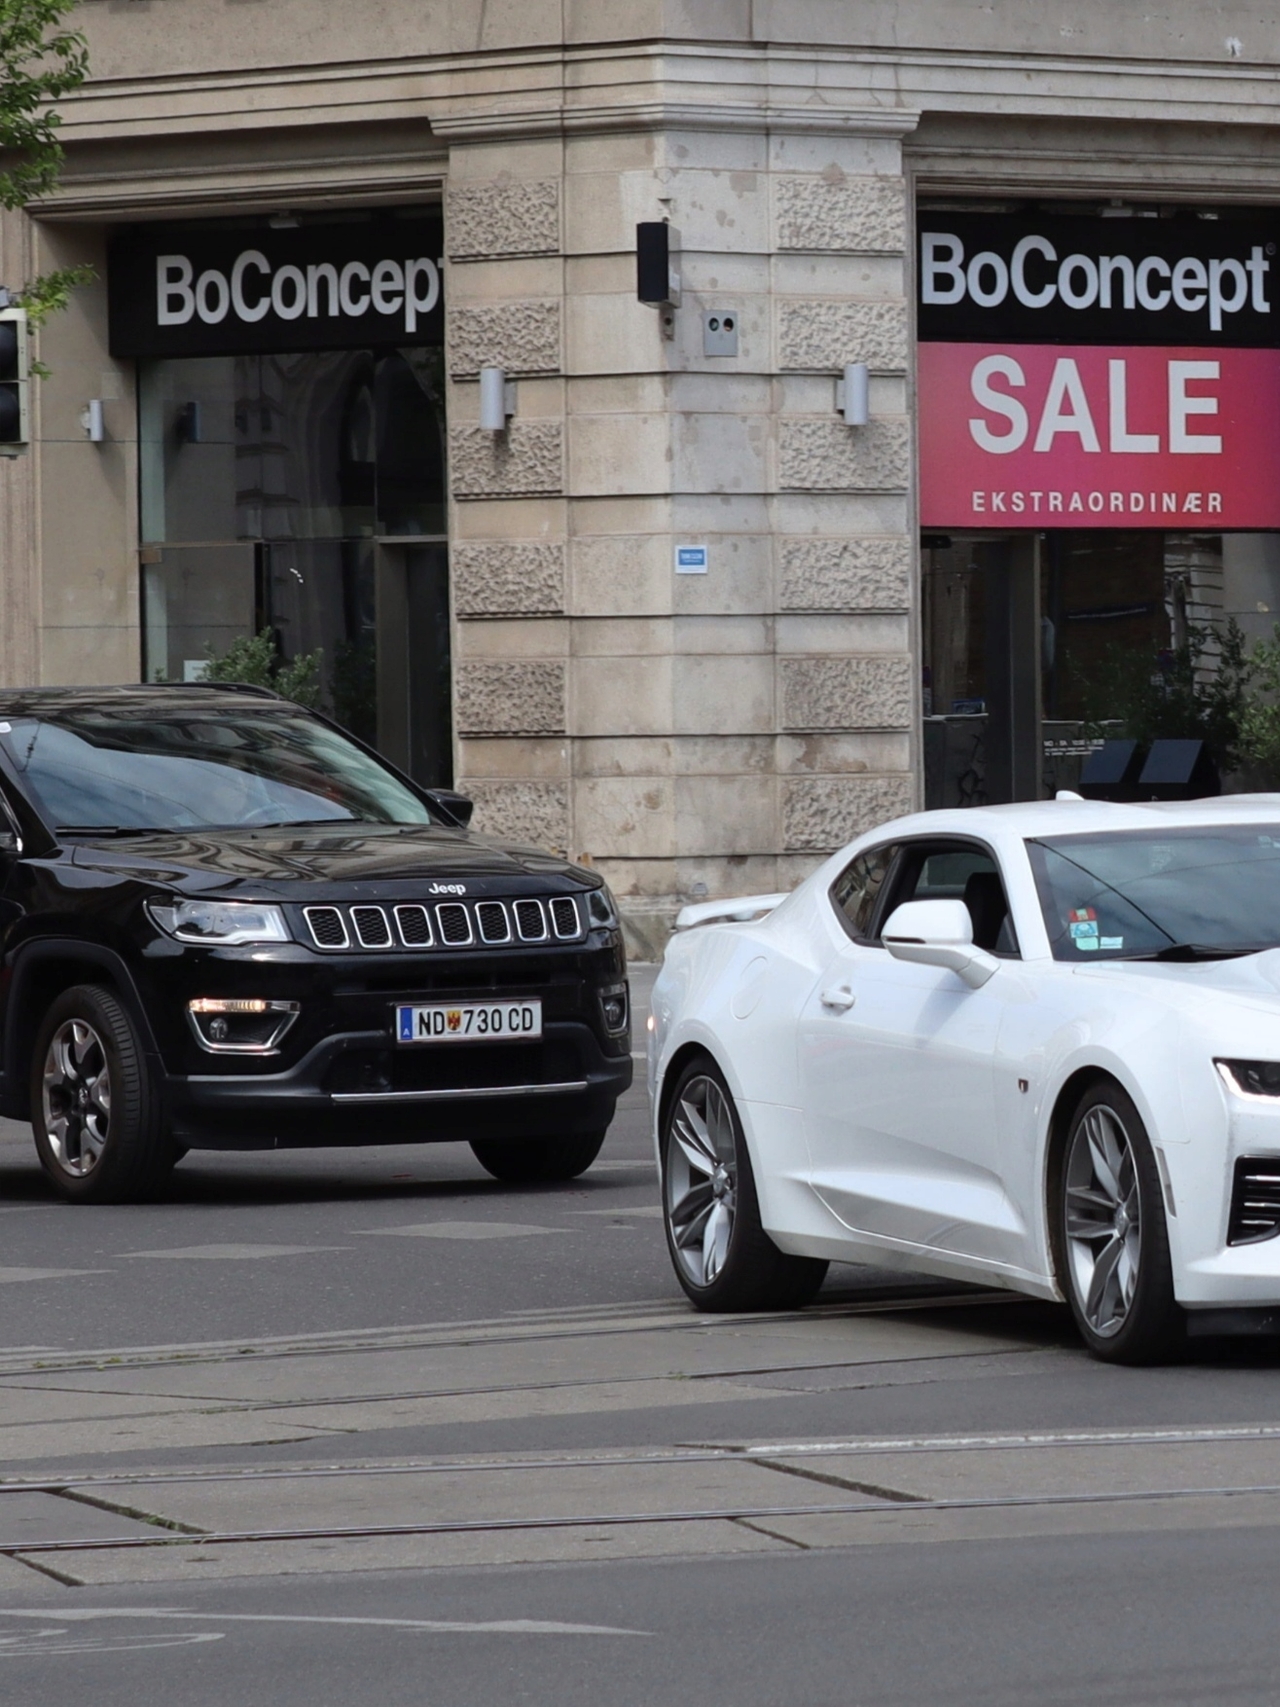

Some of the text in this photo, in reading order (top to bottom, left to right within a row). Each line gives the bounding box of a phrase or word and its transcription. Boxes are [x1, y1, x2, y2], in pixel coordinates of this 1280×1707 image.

[157, 250, 444, 333] BoConcep
[969, 354, 1222, 454] SALE
[972, 490, 1222, 513] EKSTRAORDINÆR
[429, 882, 467, 896] Jeep
[402, 1027, 411, 1036] A
[419, 1007, 534, 1036] ND 730 CD
